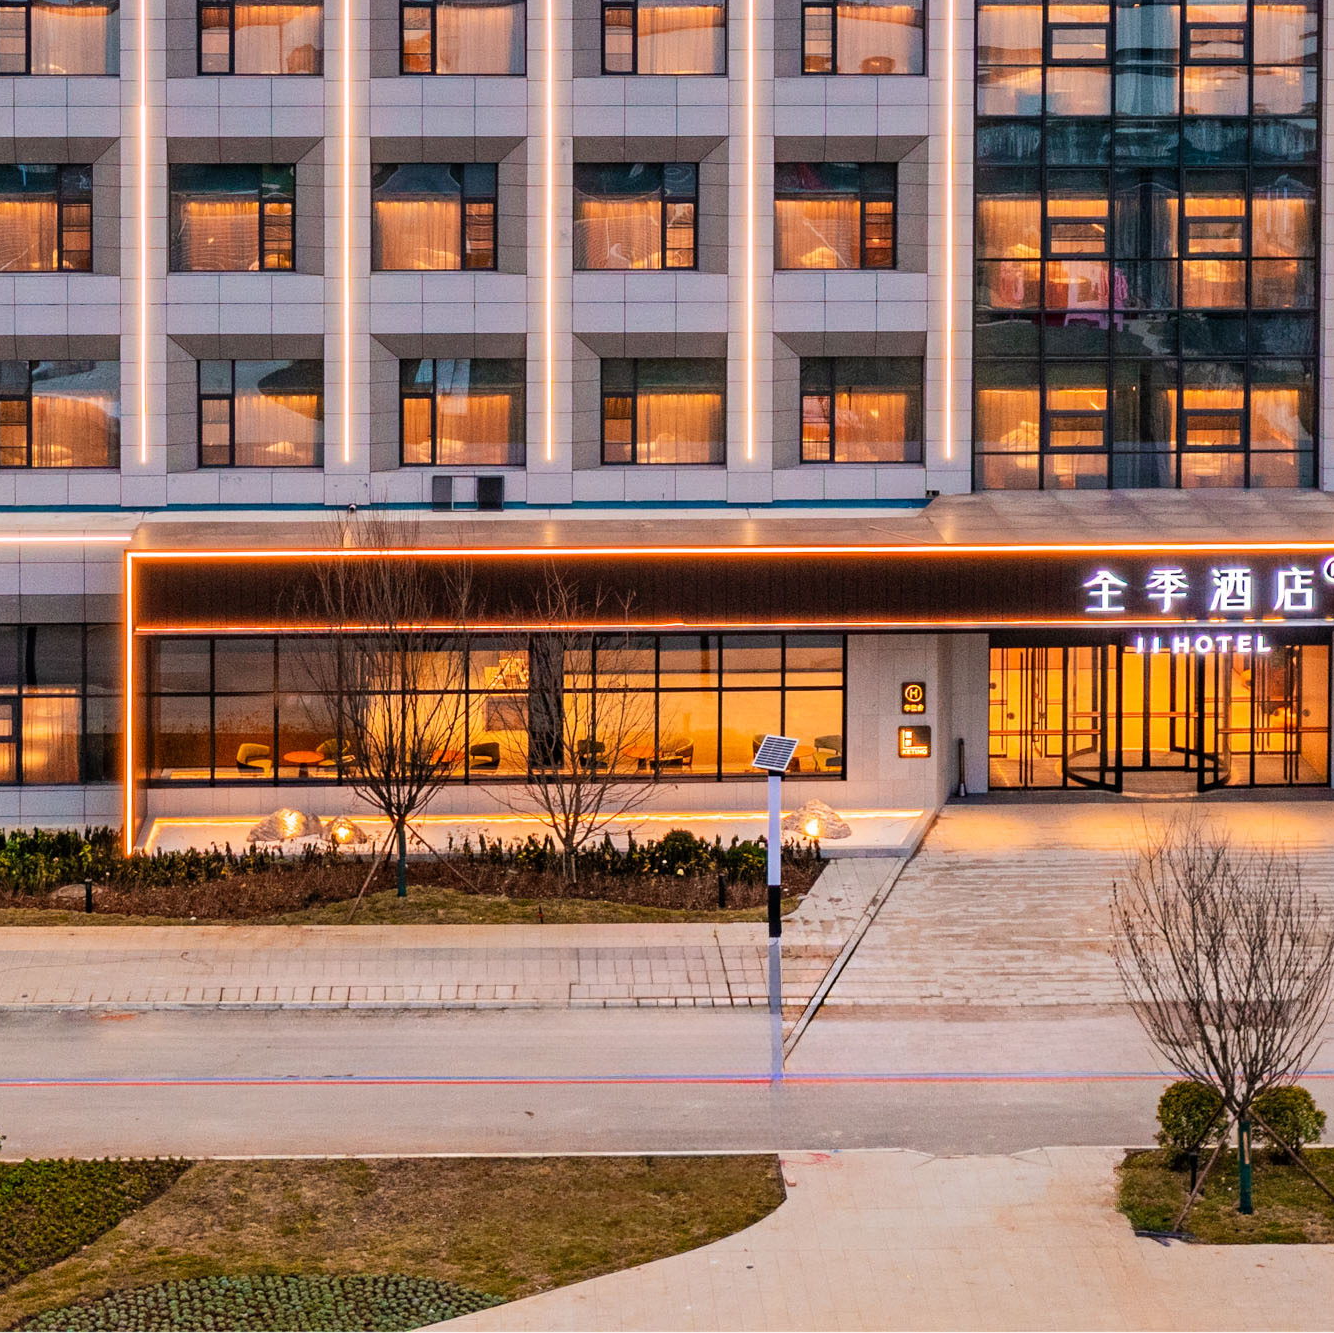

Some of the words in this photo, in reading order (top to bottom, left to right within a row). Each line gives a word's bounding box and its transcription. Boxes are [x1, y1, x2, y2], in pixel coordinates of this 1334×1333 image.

[1083, 566, 1315, 612] 全季酒店
[1173, 635, 1272, 654] HOTEL
